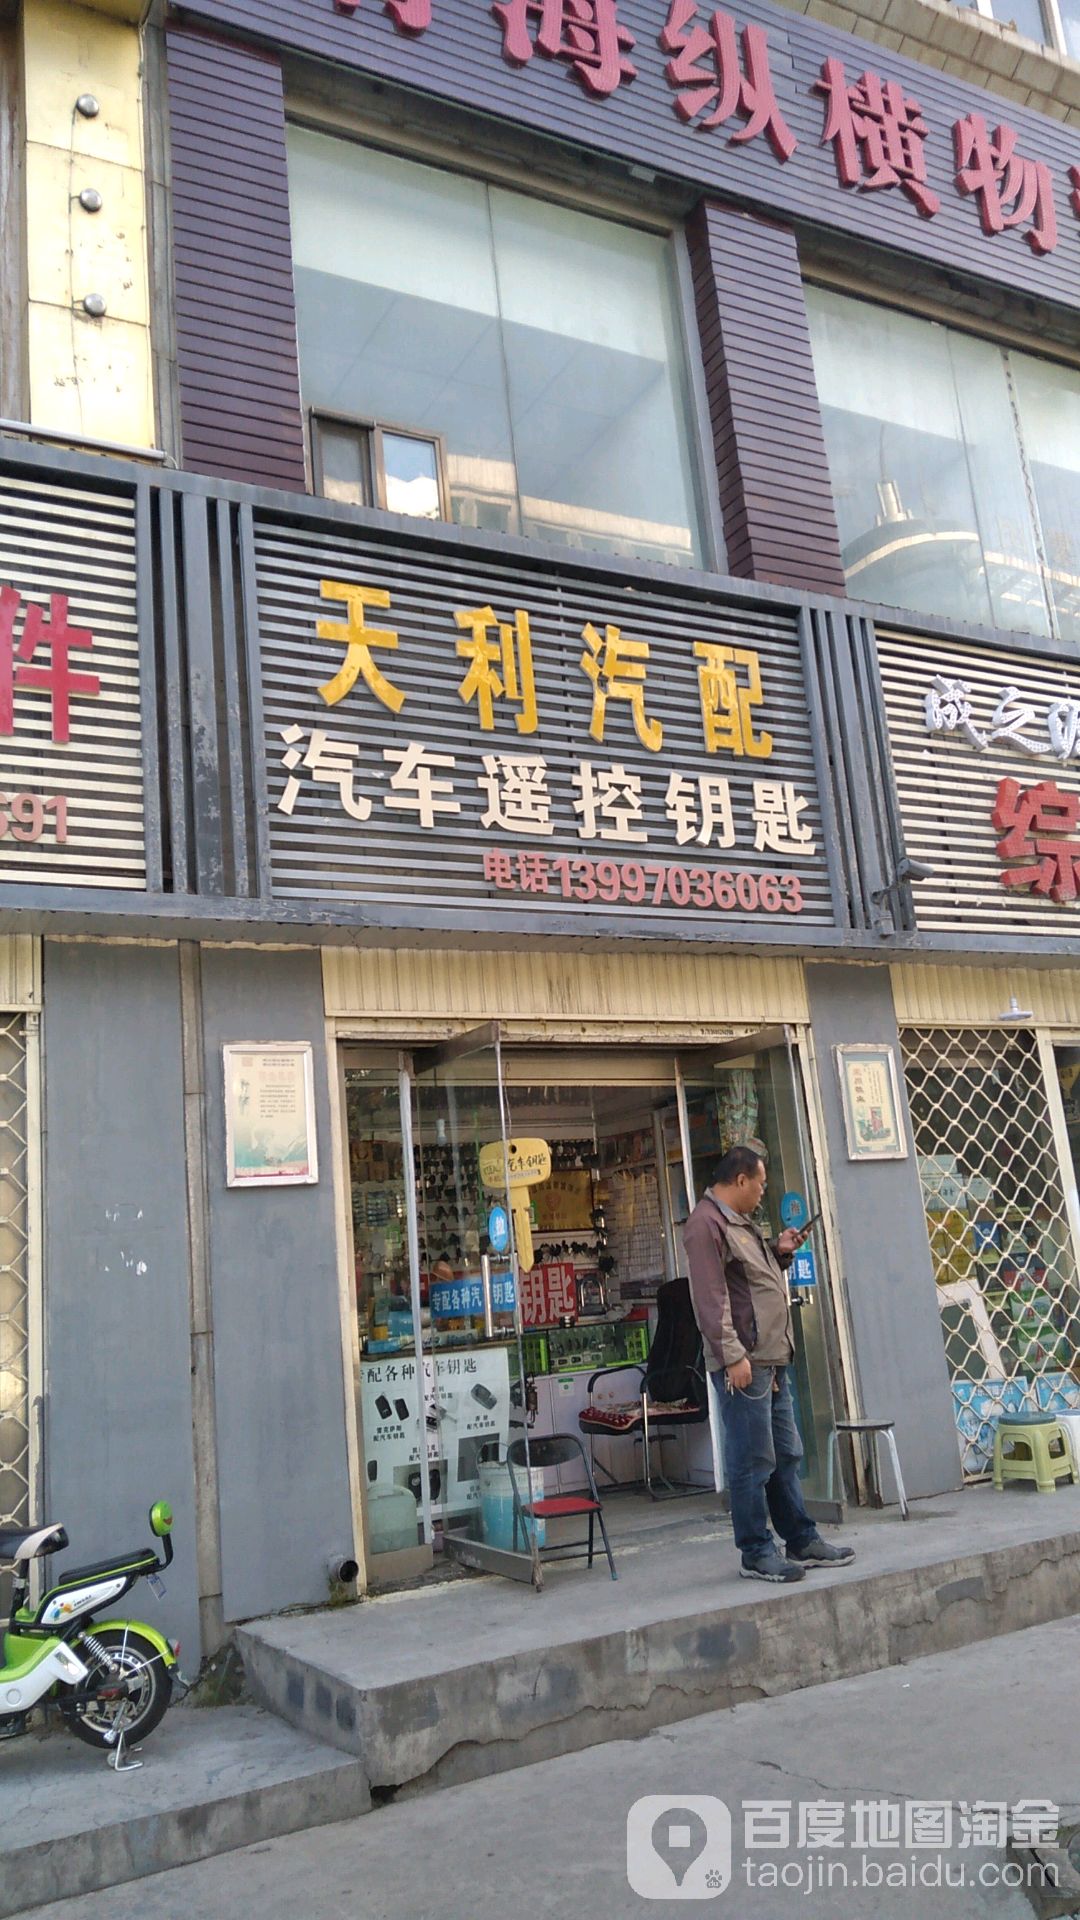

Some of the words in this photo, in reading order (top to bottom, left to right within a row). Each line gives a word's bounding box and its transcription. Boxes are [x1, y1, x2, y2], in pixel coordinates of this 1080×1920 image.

[0, 584, 100, 744] 件
[316, 579, 772, 758] 天利汽配
[0, 792, 68, 844] 91
[277, 723, 816, 856] 汽车遥控钥匙
[483, 848, 804, 913] 电话13997036063
[432, 1279, 515, 1311] 专配各种汽钥匙
